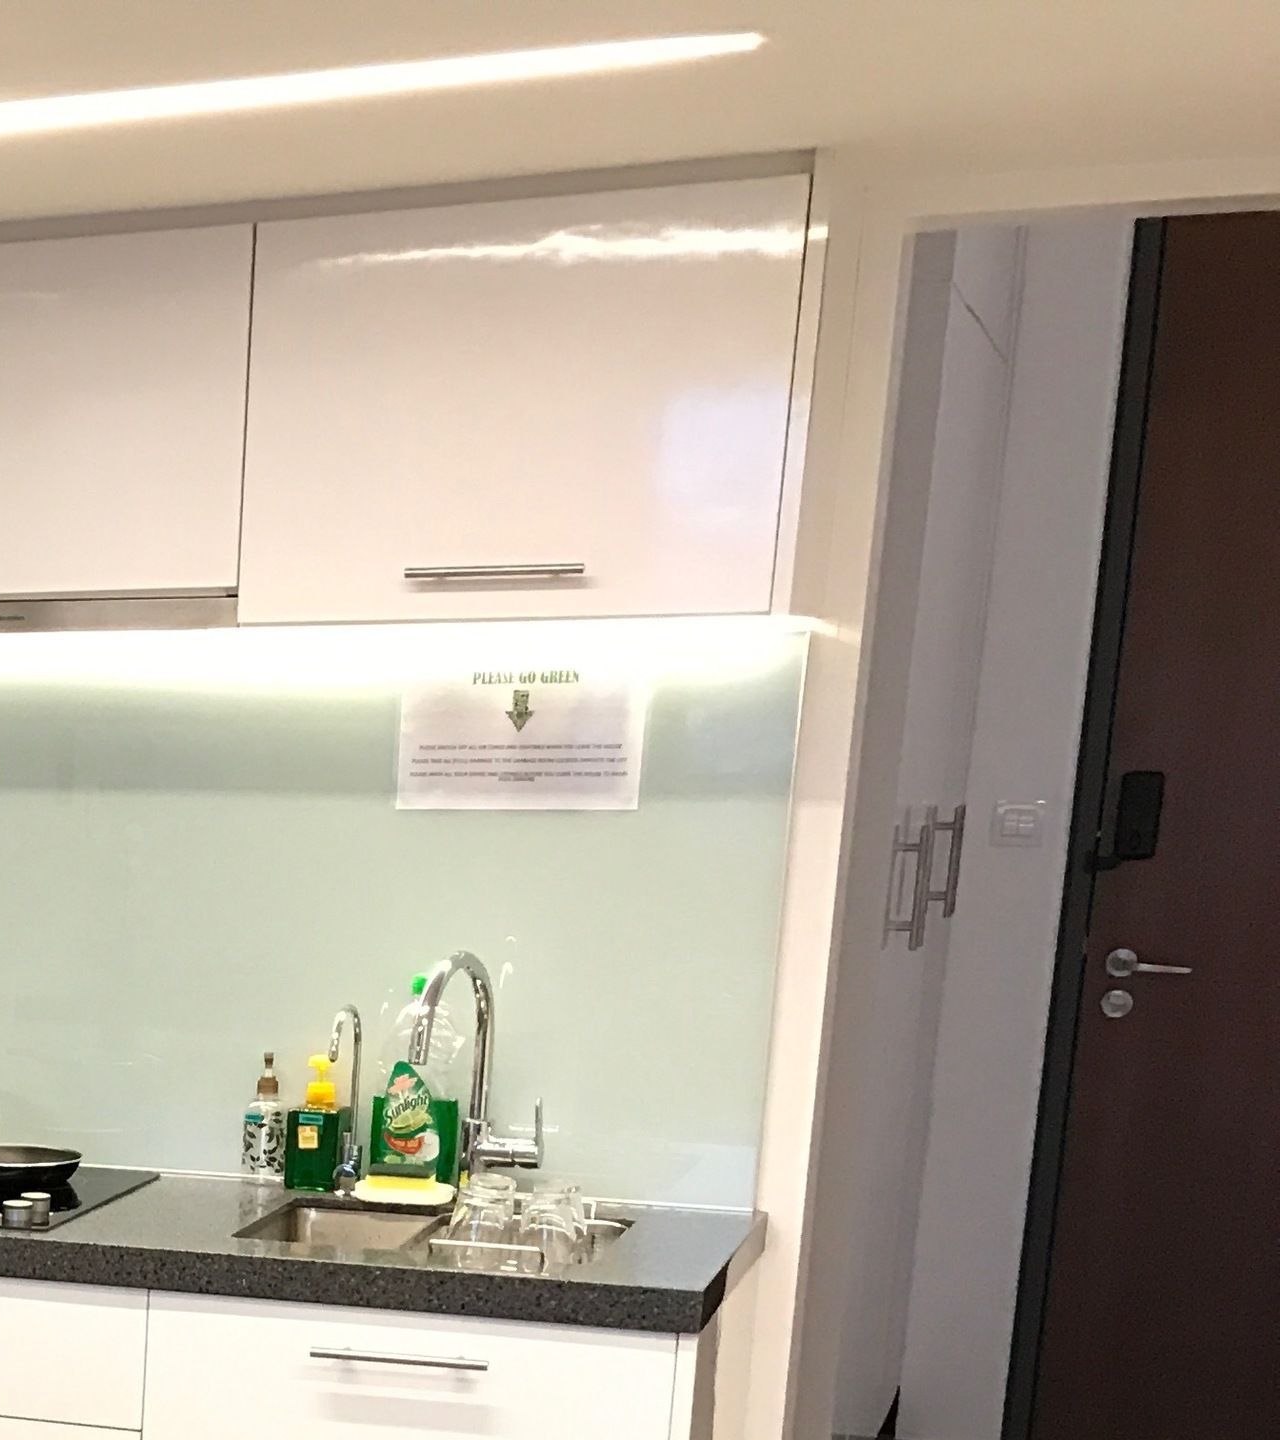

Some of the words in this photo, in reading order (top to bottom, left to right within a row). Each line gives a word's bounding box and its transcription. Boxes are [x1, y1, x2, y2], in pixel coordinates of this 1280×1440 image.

[472, 672, 515, 685] PLEASE
[519, 671, 536, 684] GO
[540, 670, 580, 684] GREEN
[383, 1094, 428, 1127] Sunlight
